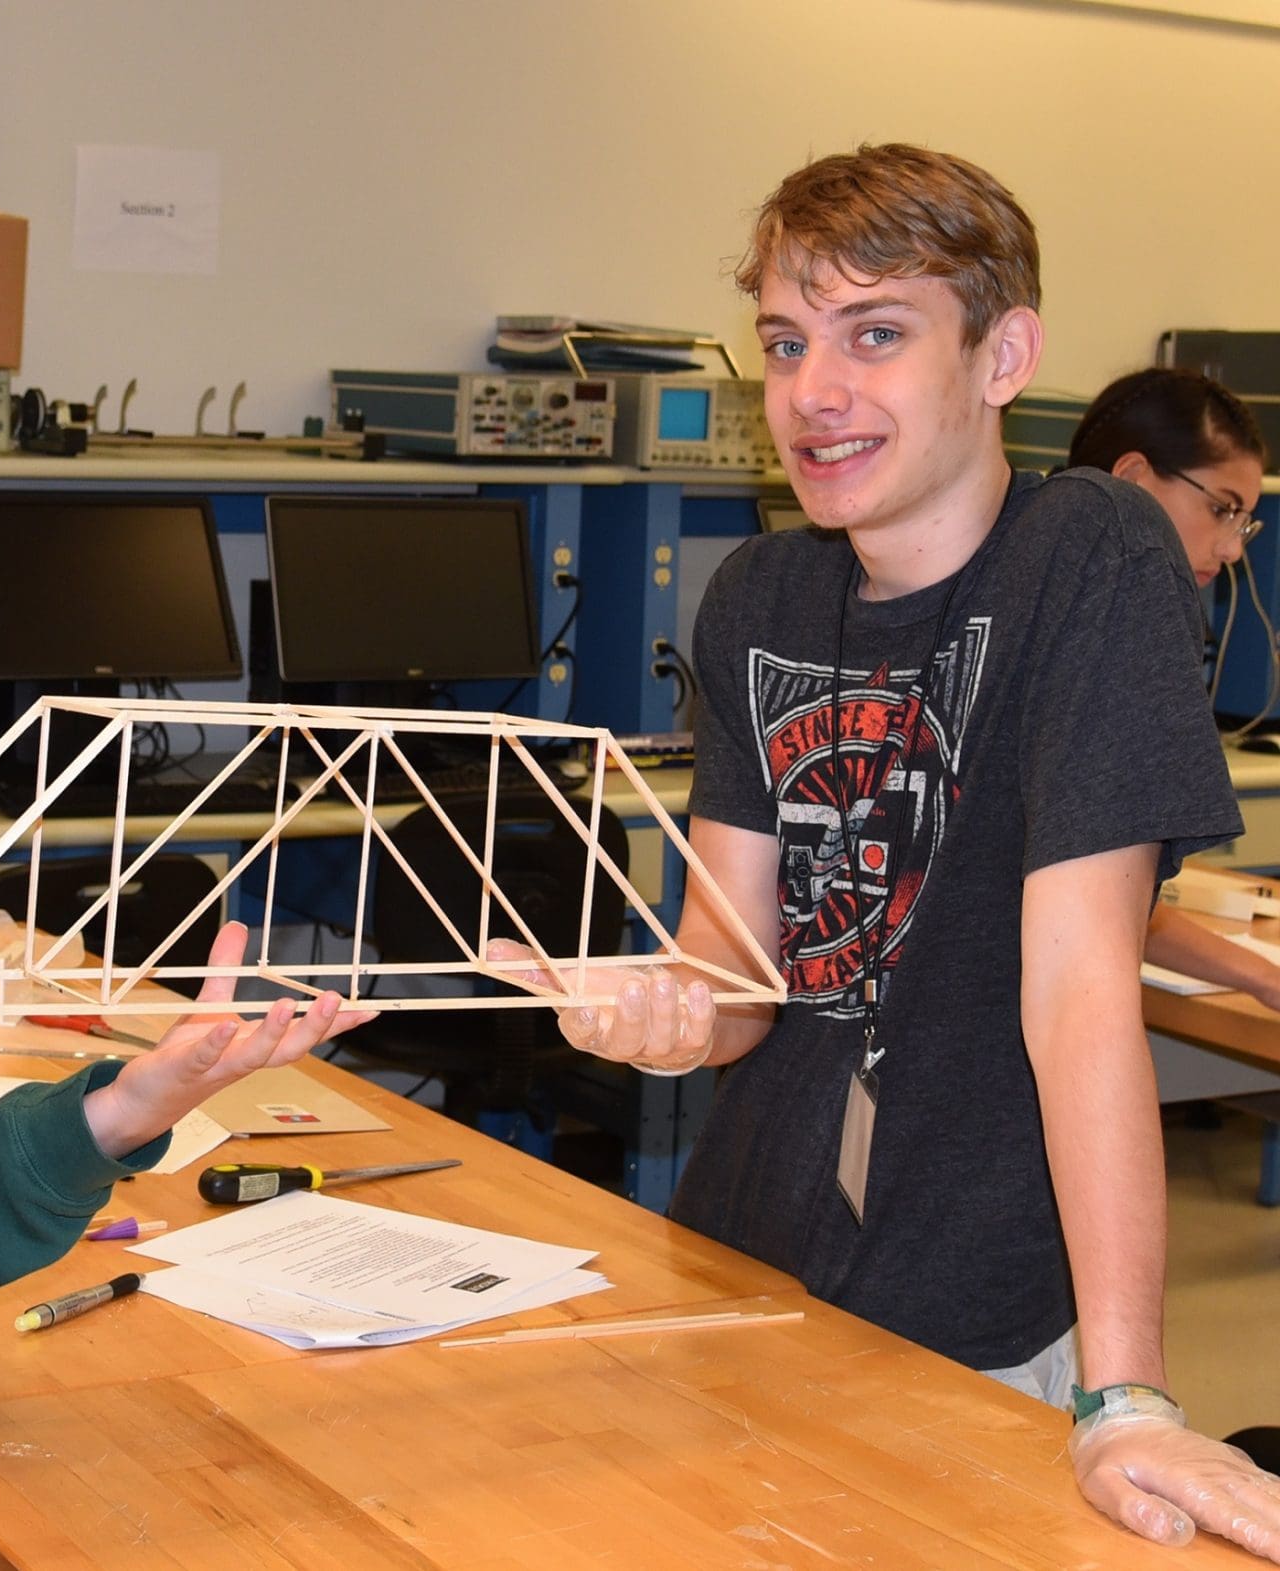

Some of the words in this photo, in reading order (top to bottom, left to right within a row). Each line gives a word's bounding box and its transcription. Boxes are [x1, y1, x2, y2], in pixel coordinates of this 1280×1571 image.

[120, 200, 165, 216] Section
[167, 203, 176, 218] 2
[779, 703, 866, 762] SINCE
